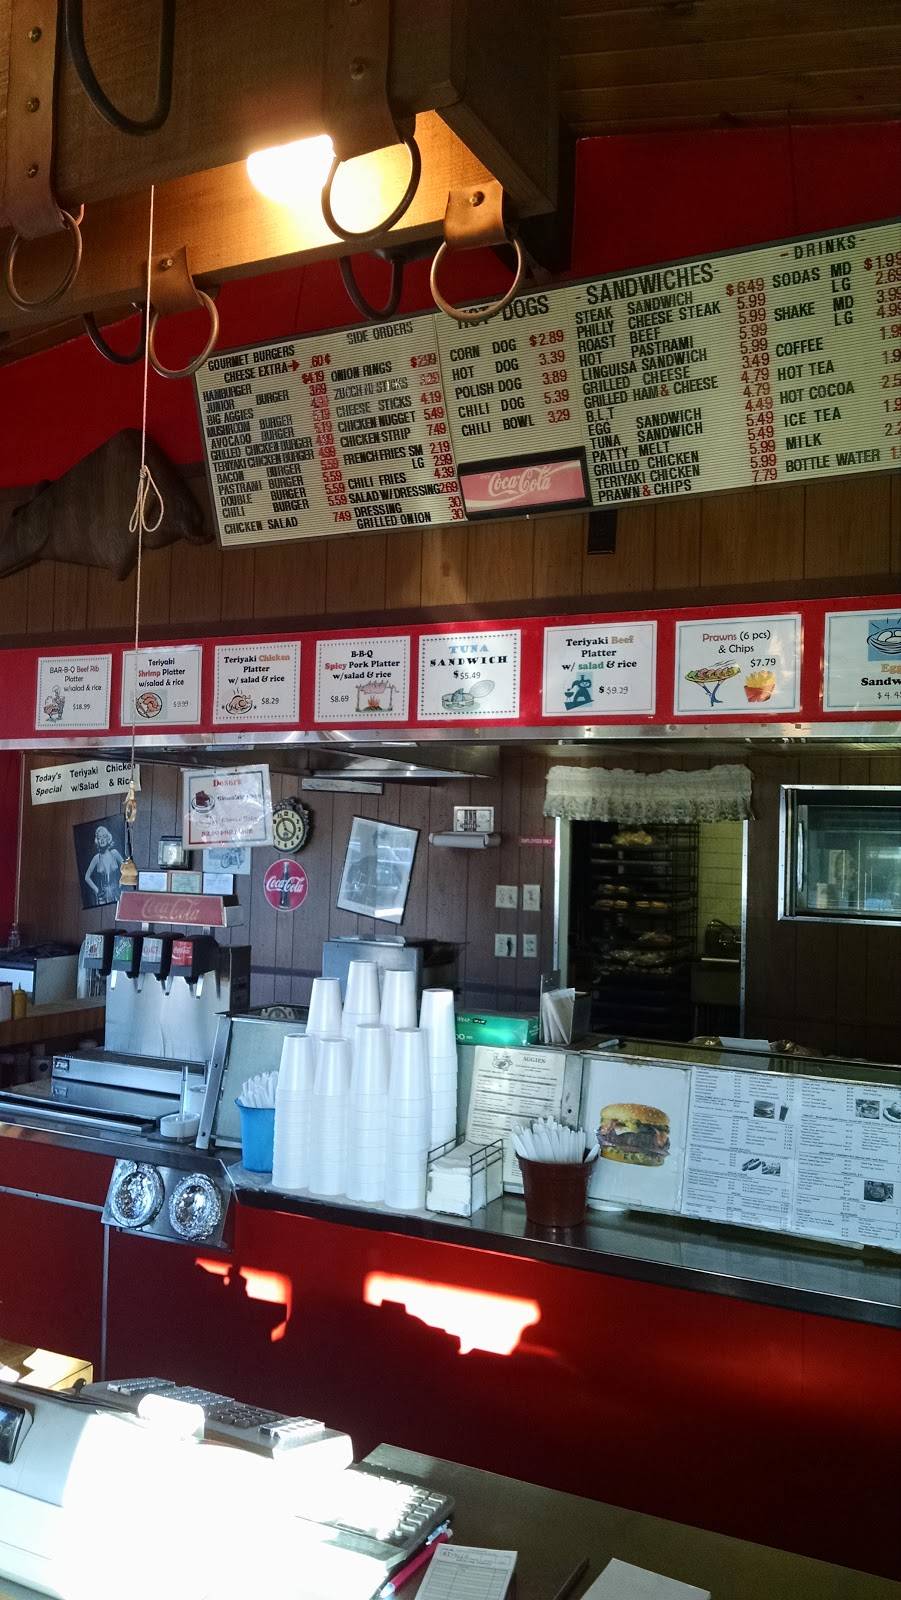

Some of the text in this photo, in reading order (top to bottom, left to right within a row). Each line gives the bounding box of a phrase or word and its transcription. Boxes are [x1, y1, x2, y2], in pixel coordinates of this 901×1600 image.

[794, 235, 856, 260] DRINKS
[773, 262, 851, 288] SODAS MD
[832, 278, 850, 293] LG
[502, 295, 549, 321] DOGS
[575, 291, 693, 324] STEAK SANDWICH
[576, 293, 766, 339] PHILLY CHEESE STEAK 5.99
[774, 296, 854, 321] SHAKE MD
[834, 311, 853, 326] LG
[347, 321, 413, 344] SIDE ORDERS
[578, 308, 766, 353] ROAST BEEF 5.99
[253, 345, 294, 363] BURGERS
[450, 330, 564, 361] CORN DOG $2.89
[579, 323, 767, 367] HOT PASTRAMI 5.99
[776, 337, 823, 357] COFFEE
[452, 366, 474, 380] HOT
[495, 358, 518, 373] DOG
[539, 350, 565, 366] 3.39
[581, 338, 768, 381] LINGUISA SANDWICH 5.99
[224, 362, 288, 383] CHEESE EXTRA
[331, 367, 360, 382] ONION
[777, 360, 834, 381] HOT TEA
[455, 370, 567, 400] POLISH DOG 3.89
[583, 366, 690, 395] GRILLED CHEESE
[584, 376, 718, 409] GRILLED CHEESE
[780, 381, 855, 404] HOT COCOA
[336, 395, 412, 418] CHEESE STICKS
[458, 389, 569, 418] CHILI DOG 5.39
[338, 411, 416, 432] CHICKEN NUGGET
[462, 415, 535, 436] CHILI BOWL
[588, 408, 702, 436] EGG SANDWICH
[784, 407, 841, 427] ICE TEA
[340, 428, 411, 447] CHICKEN STRIP
[590, 422, 703, 449] TUNA SANDWICH
[786, 433, 822, 450] MILK
[380, 447, 406, 460] FRIES
[592, 441, 670, 463] PATTY MELT
[786, 449, 880, 472] BOTTLE WATER
[412, 457, 424, 469] LG
[594, 450, 699, 476] GRILLED CHICKEN
[348, 472, 407, 490] CHILI FRIES
[595, 464, 700, 489] TERIYAKI CHICKEN
[598, 479, 692, 502] PRAWN CHIPS
[354, 503, 402, 517] DRESSING
[224, 517, 298, 534] CHICKEN SALAD
[357, 512, 431, 529] GRILLED ONION
[566, 636, 634, 647] Teriyaki Beef
[702, 630, 771, 642] Prawns (6 pcs)
[351, 650, 373, 658] B-B-Q
[448, 644, 488, 654] TUNA
[582, 649, 617, 658] Platter
[718, 644, 754, 654] & Chips
[149, 658, 175, 666] Teriyaki
[224, 654, 290, 664] Teriyaki Chicken
[325, 660, 400, 671] Spicy Pork Platter
[430, 655, 508, 667] SANDWICH
[562, 660, 637, 671] w/ salad & rice
[750, 658, 776, 668] $7.79
[50, 666, 75, 674] BAR-B-Q
[139, 670, 161, 678] Shrimp
[243, 665, 270, 673] Platter
[332, 672, 364, 680] w/salad
[240, 676, 260, 684] salad
[261, 697, 279, 705] $8.29
[330, 695, 350, 703] $8.69
[36, 772, 61, 783] Today's
[70, 767, 98, 778] Teriyaki
[36, 785, 62, 796] Special
[71, 781, 99, 792] w/Salad
[109, 779, 115, 787] &
